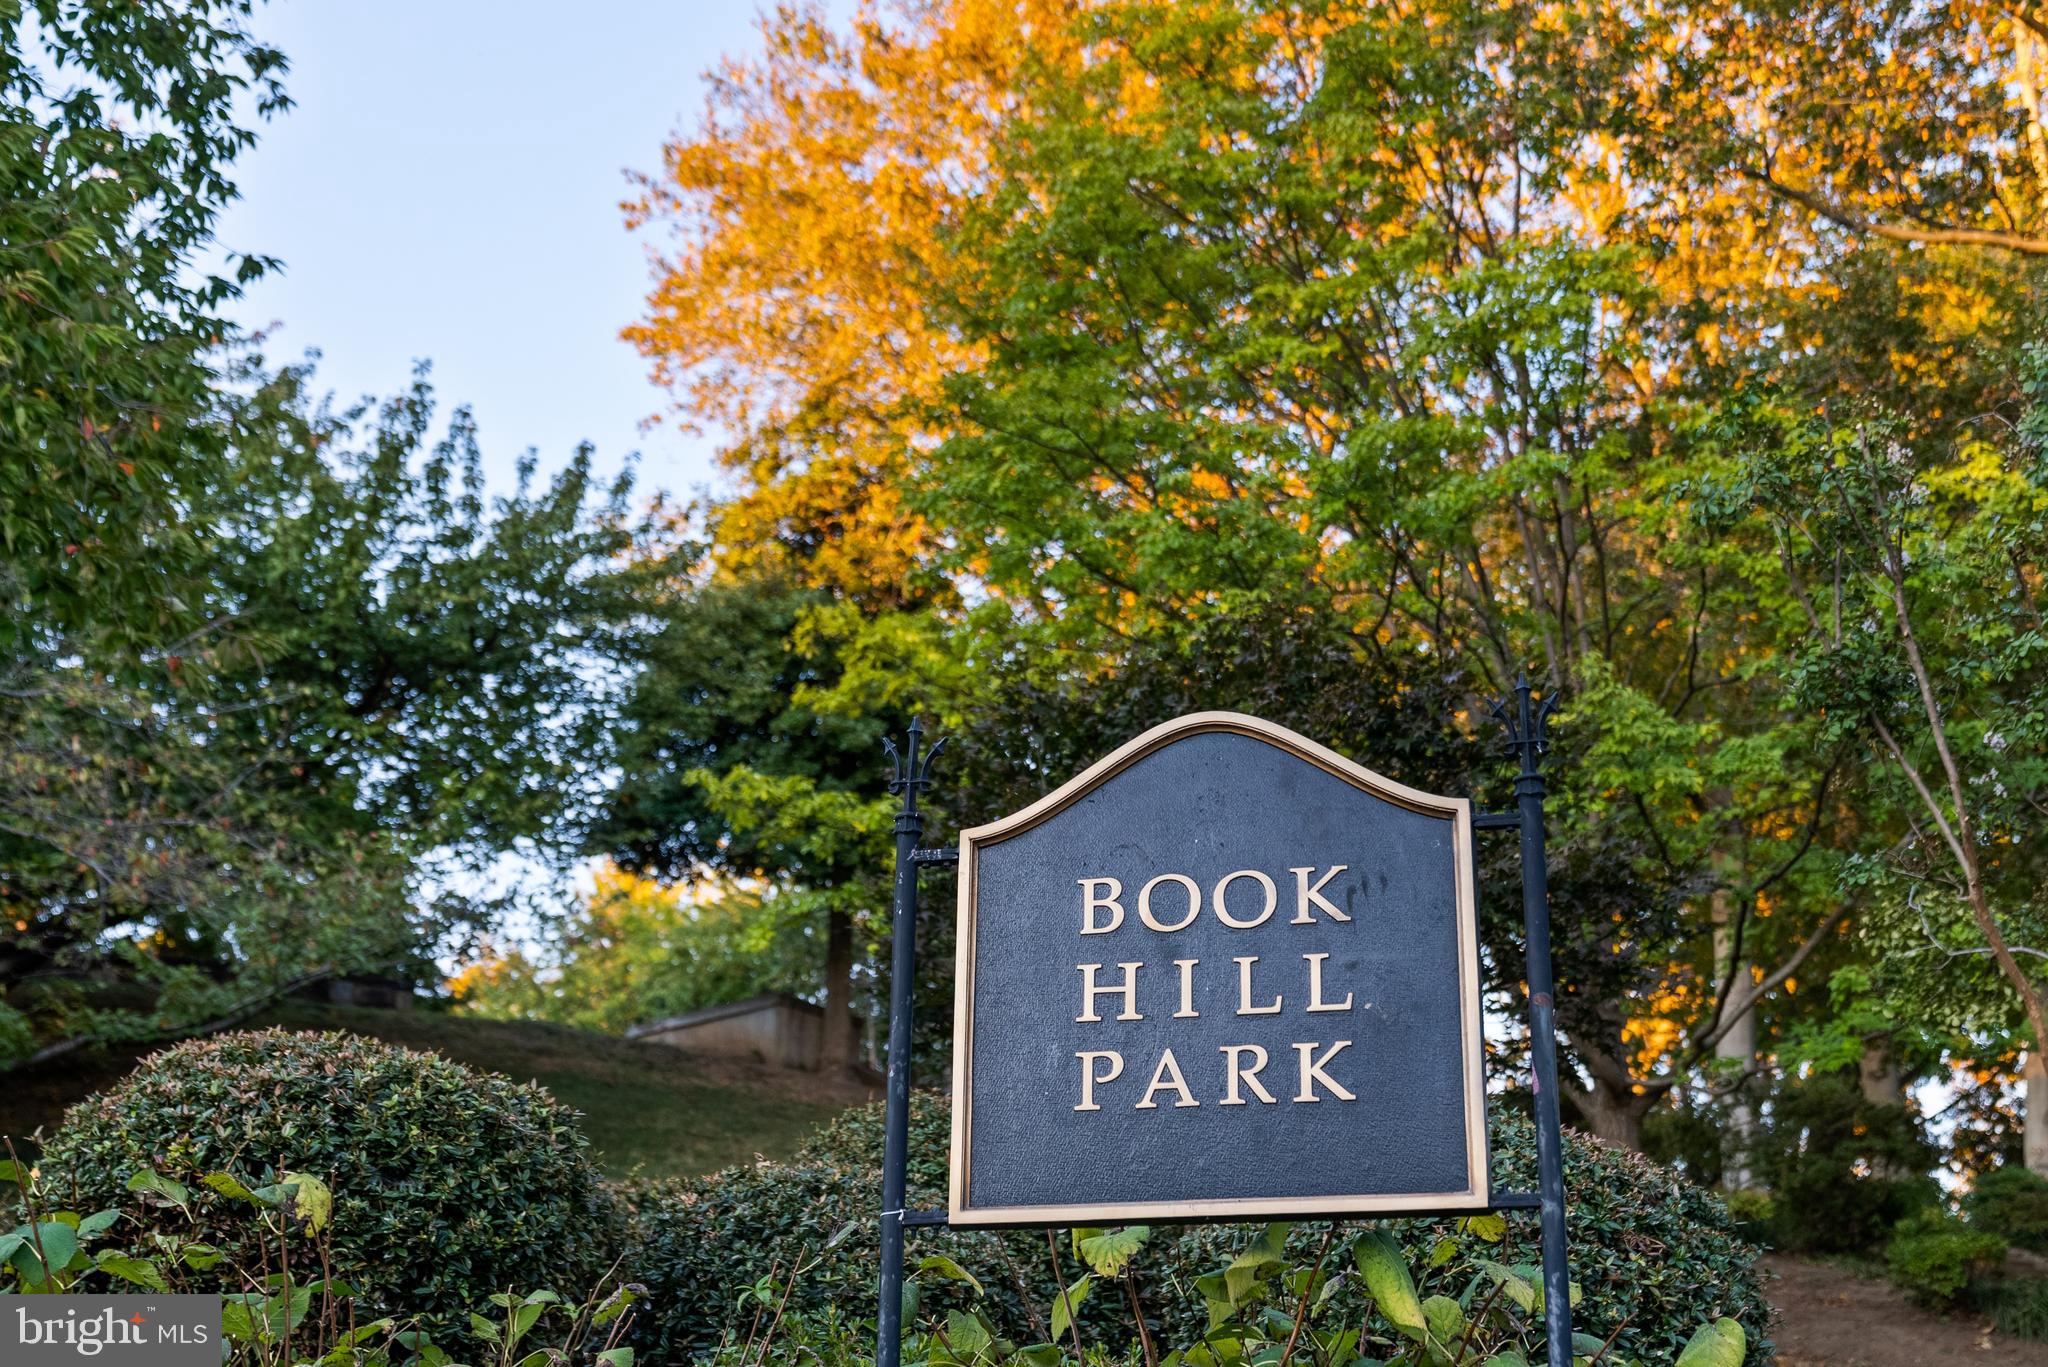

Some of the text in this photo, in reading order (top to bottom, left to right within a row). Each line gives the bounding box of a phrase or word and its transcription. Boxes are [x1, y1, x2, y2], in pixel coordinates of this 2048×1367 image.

[1076, 864, 1352, 936] BOOK
[1075, 952, 1354, 1023] HILL
[1073, 1040, 1357, 1111] PARK
